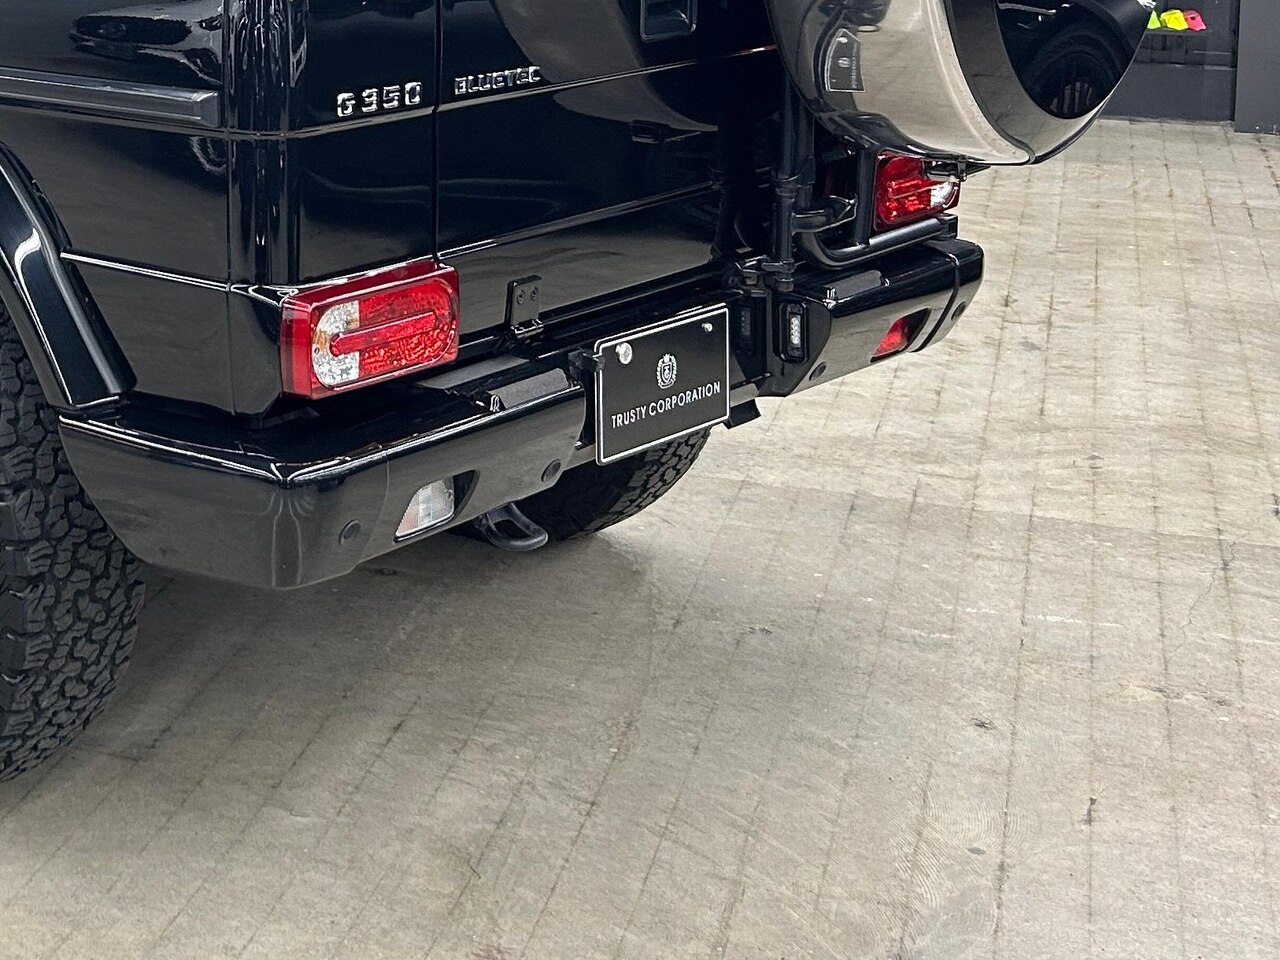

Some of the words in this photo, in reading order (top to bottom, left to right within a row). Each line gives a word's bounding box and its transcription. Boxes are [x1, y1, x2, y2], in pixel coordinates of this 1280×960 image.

[454, 65, 541, 96] BLUETEC
[336, 92, 355, 118] G
[361, 81, 422, 113] 350
[611, 404, 647, 429] TRUSTY
[648, 380, 721, 417] CORPORATION
